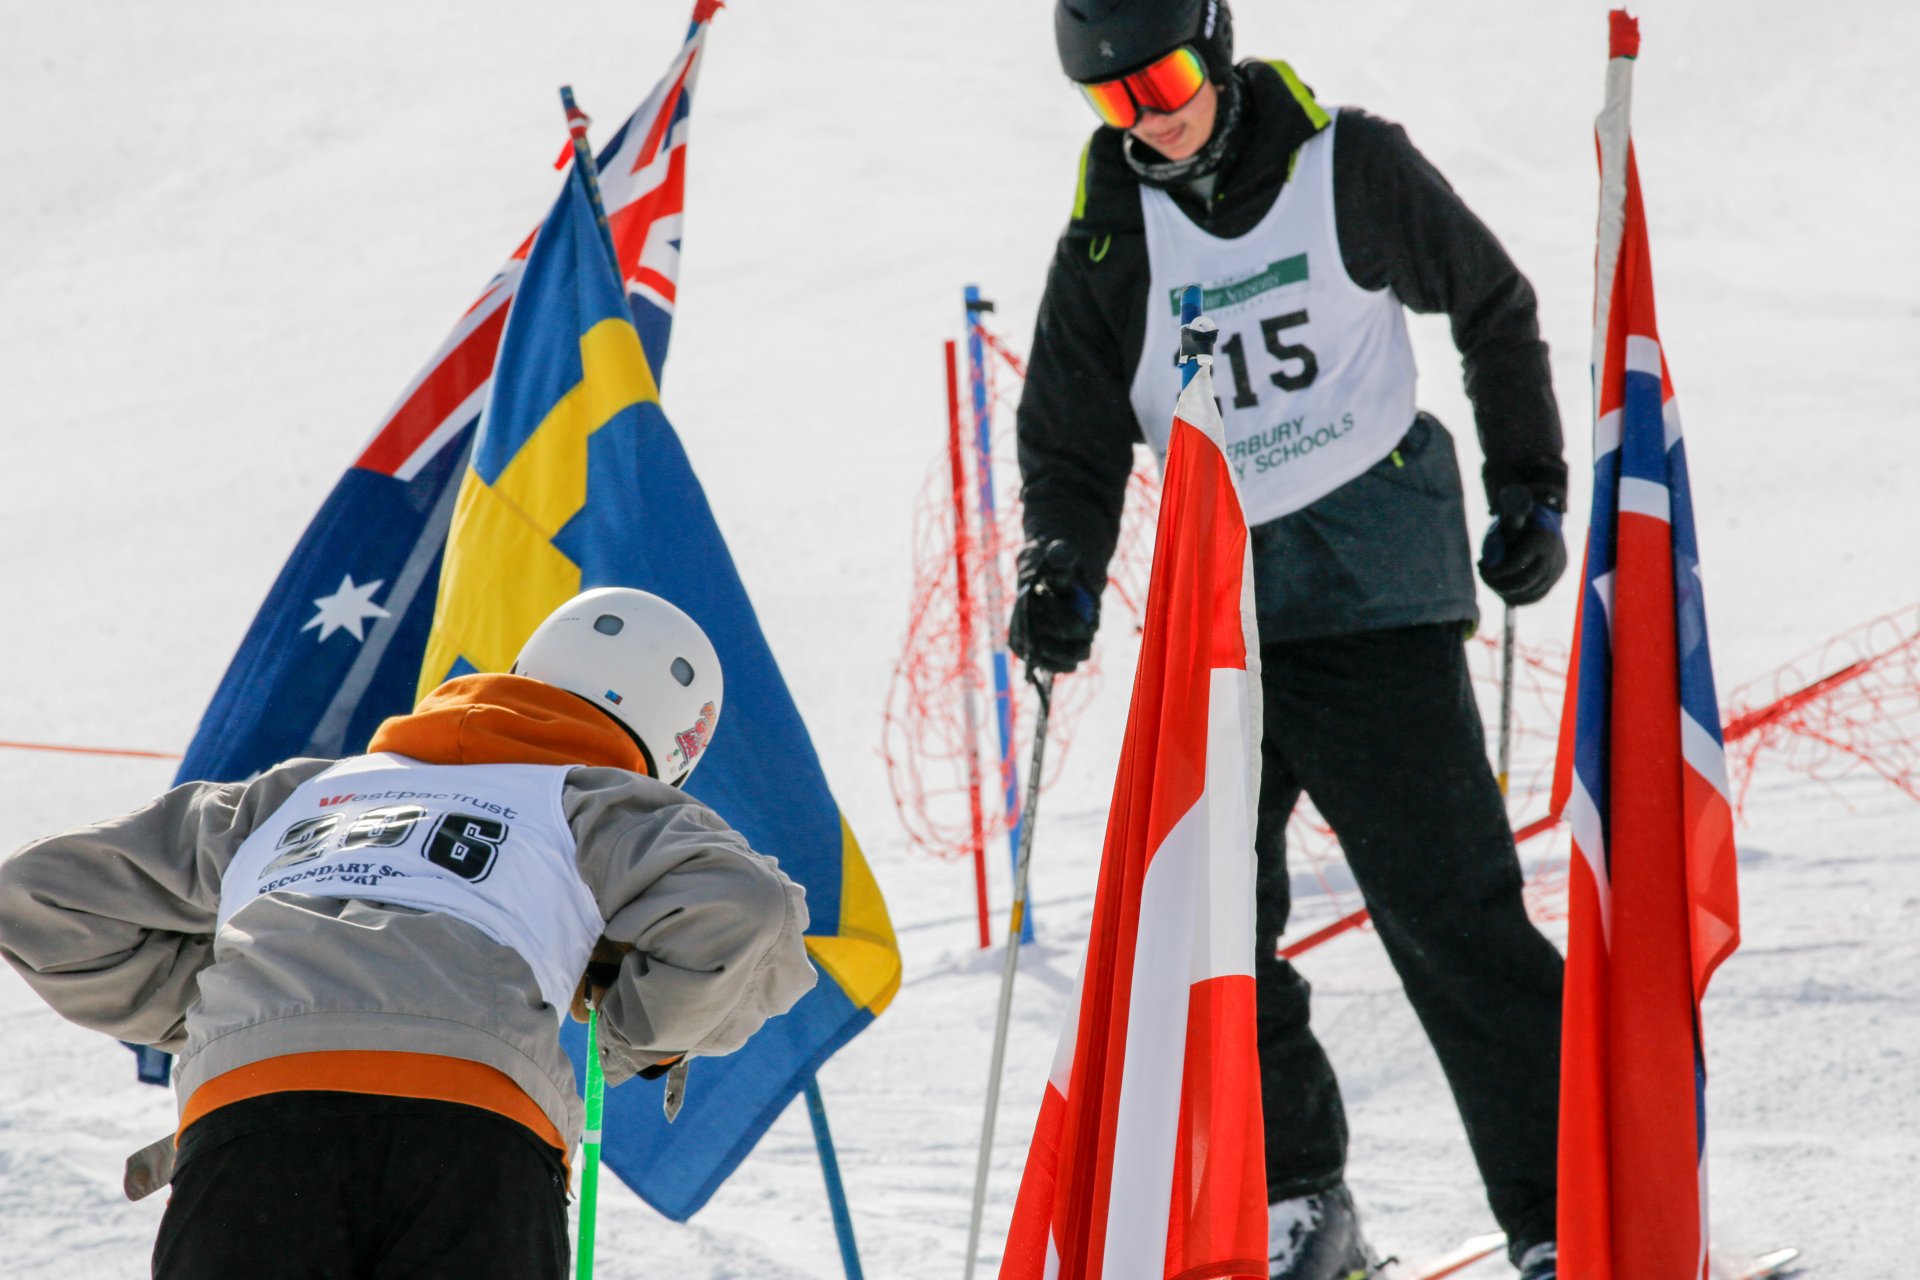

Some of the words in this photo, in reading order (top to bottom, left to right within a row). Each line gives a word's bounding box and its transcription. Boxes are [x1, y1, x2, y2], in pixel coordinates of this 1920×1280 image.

[1254, 412, 1356, 474] SCHOOLS
[318, 790, 519, 820] WestpacTrust
[258, 862, 377, 895] SECONDARY
